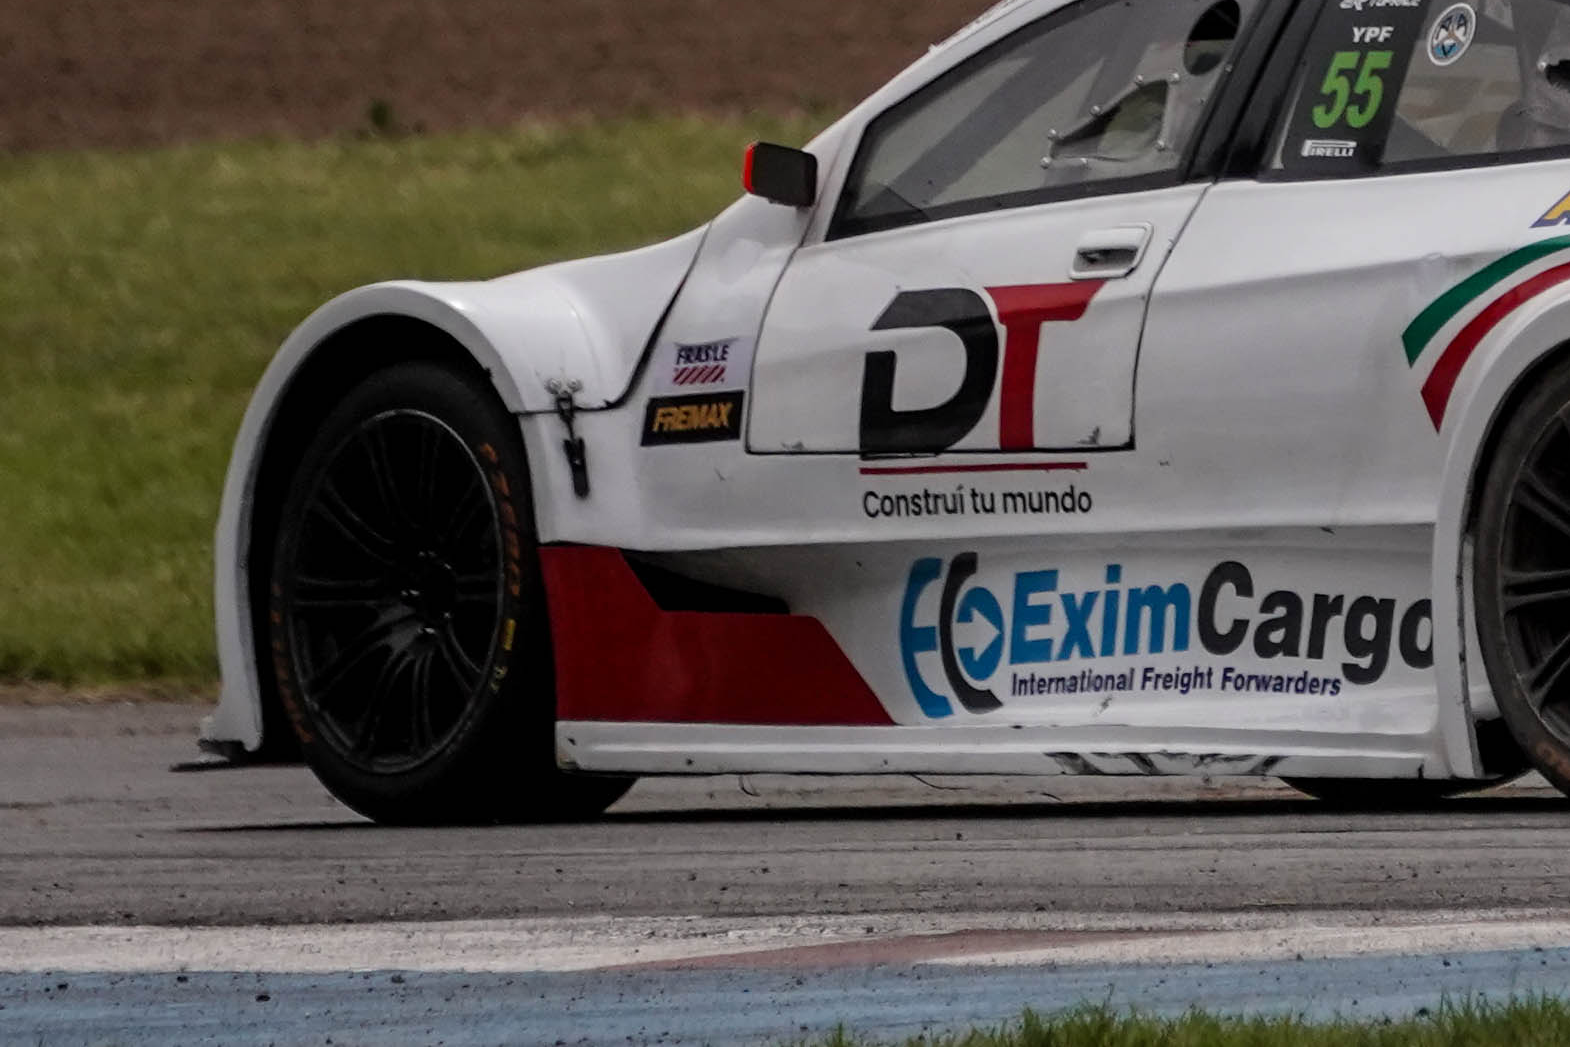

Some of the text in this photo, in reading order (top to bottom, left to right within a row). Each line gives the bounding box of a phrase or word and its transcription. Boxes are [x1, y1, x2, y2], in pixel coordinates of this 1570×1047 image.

[1352, 26, 1394, 43] YPF
[1312, 51, 1394, 128] 55
[1301, 139, 1357, 157] PIRELLI
[860, 279, 1107, 460] DT
[652, 401, 733, 432] FREMAX
[863, 483, 1092, 518] Construí tu mundo
[1012, 667, 1342, 697] International Freight Forwarders
